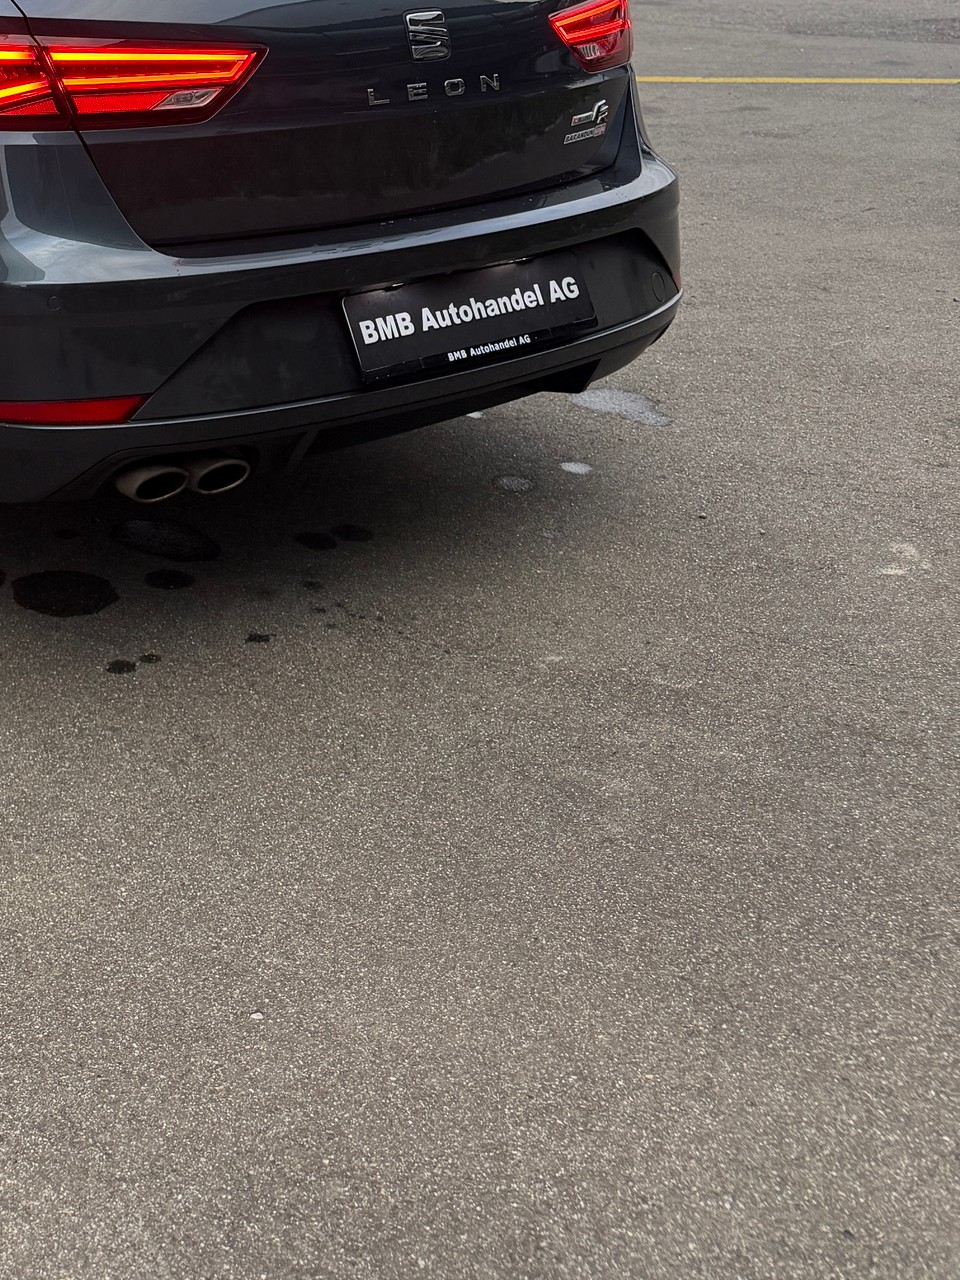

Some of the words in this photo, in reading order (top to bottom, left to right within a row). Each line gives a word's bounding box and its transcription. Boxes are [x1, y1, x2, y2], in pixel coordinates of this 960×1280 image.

[367, 73, 500, 106] LEON
[359, 312, 415, 345] BMB
[421, 284, 545, 332] Autohandel
[549, 276, 580, 304] AG
[447, 349, 468, 362] BMB
[469, 338, 518, 358] Autohandel
[518, 333, 532, 345] AG
